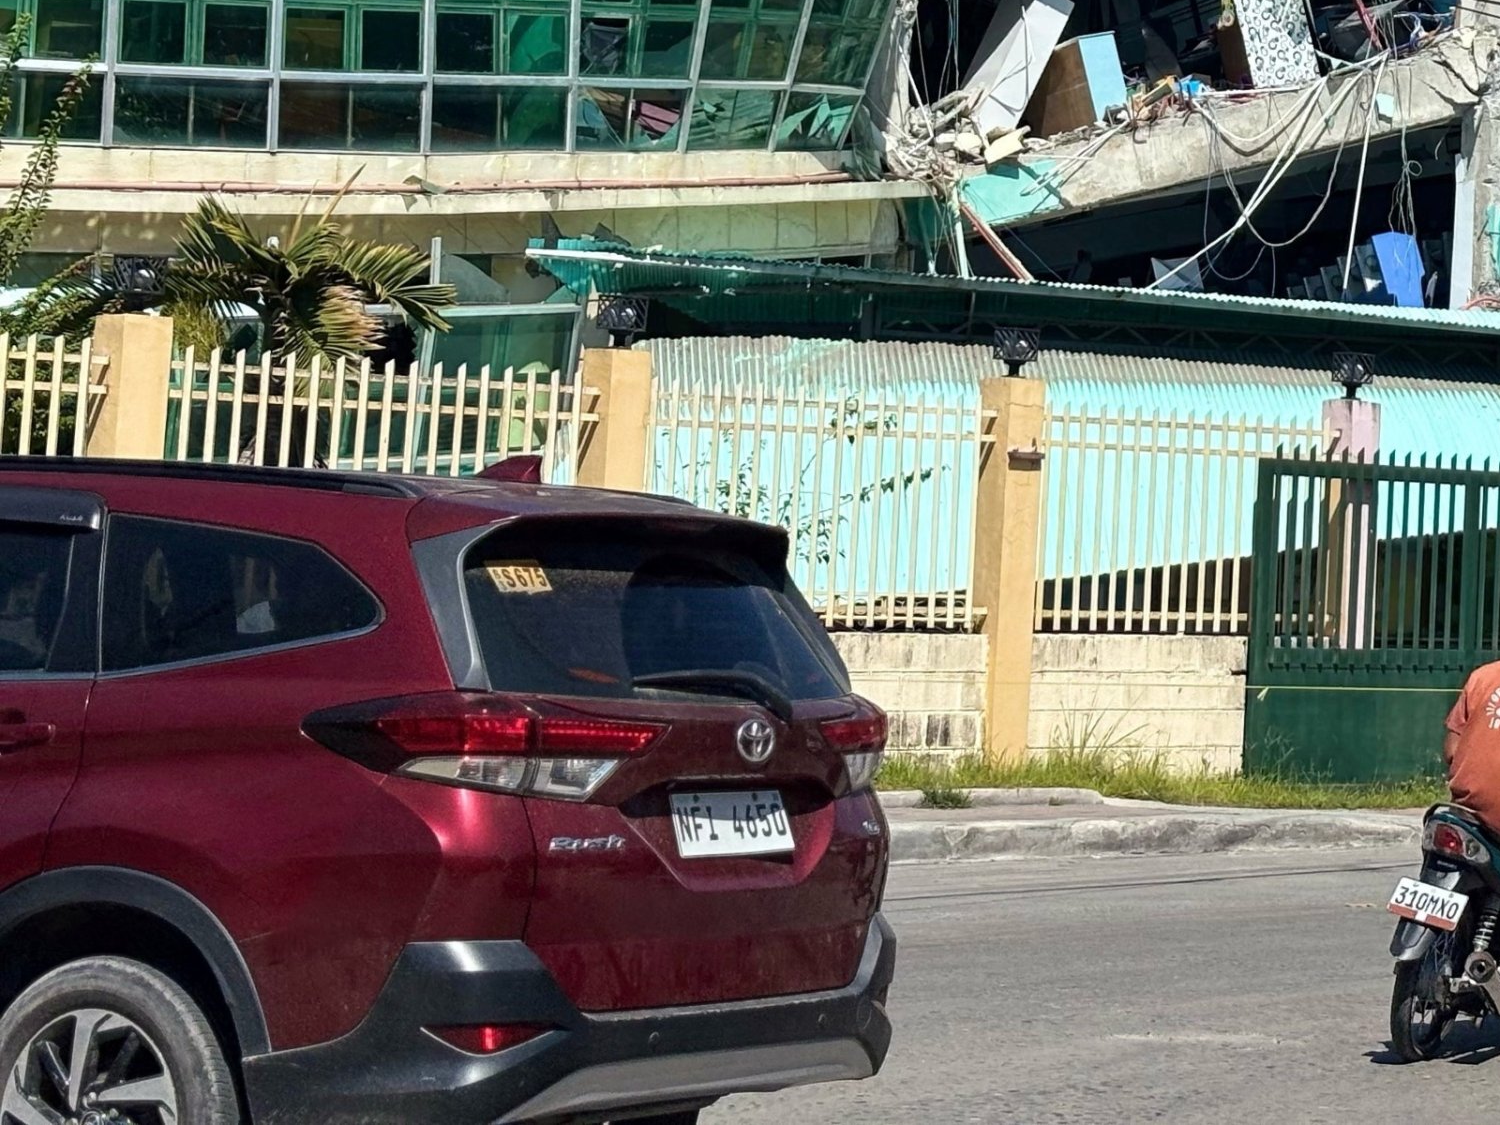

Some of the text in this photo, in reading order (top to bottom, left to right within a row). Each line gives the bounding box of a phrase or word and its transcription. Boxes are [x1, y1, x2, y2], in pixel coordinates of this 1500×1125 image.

[501, 567, 548, 588] S675
[677, 803, 787, 842] NFI 4650
